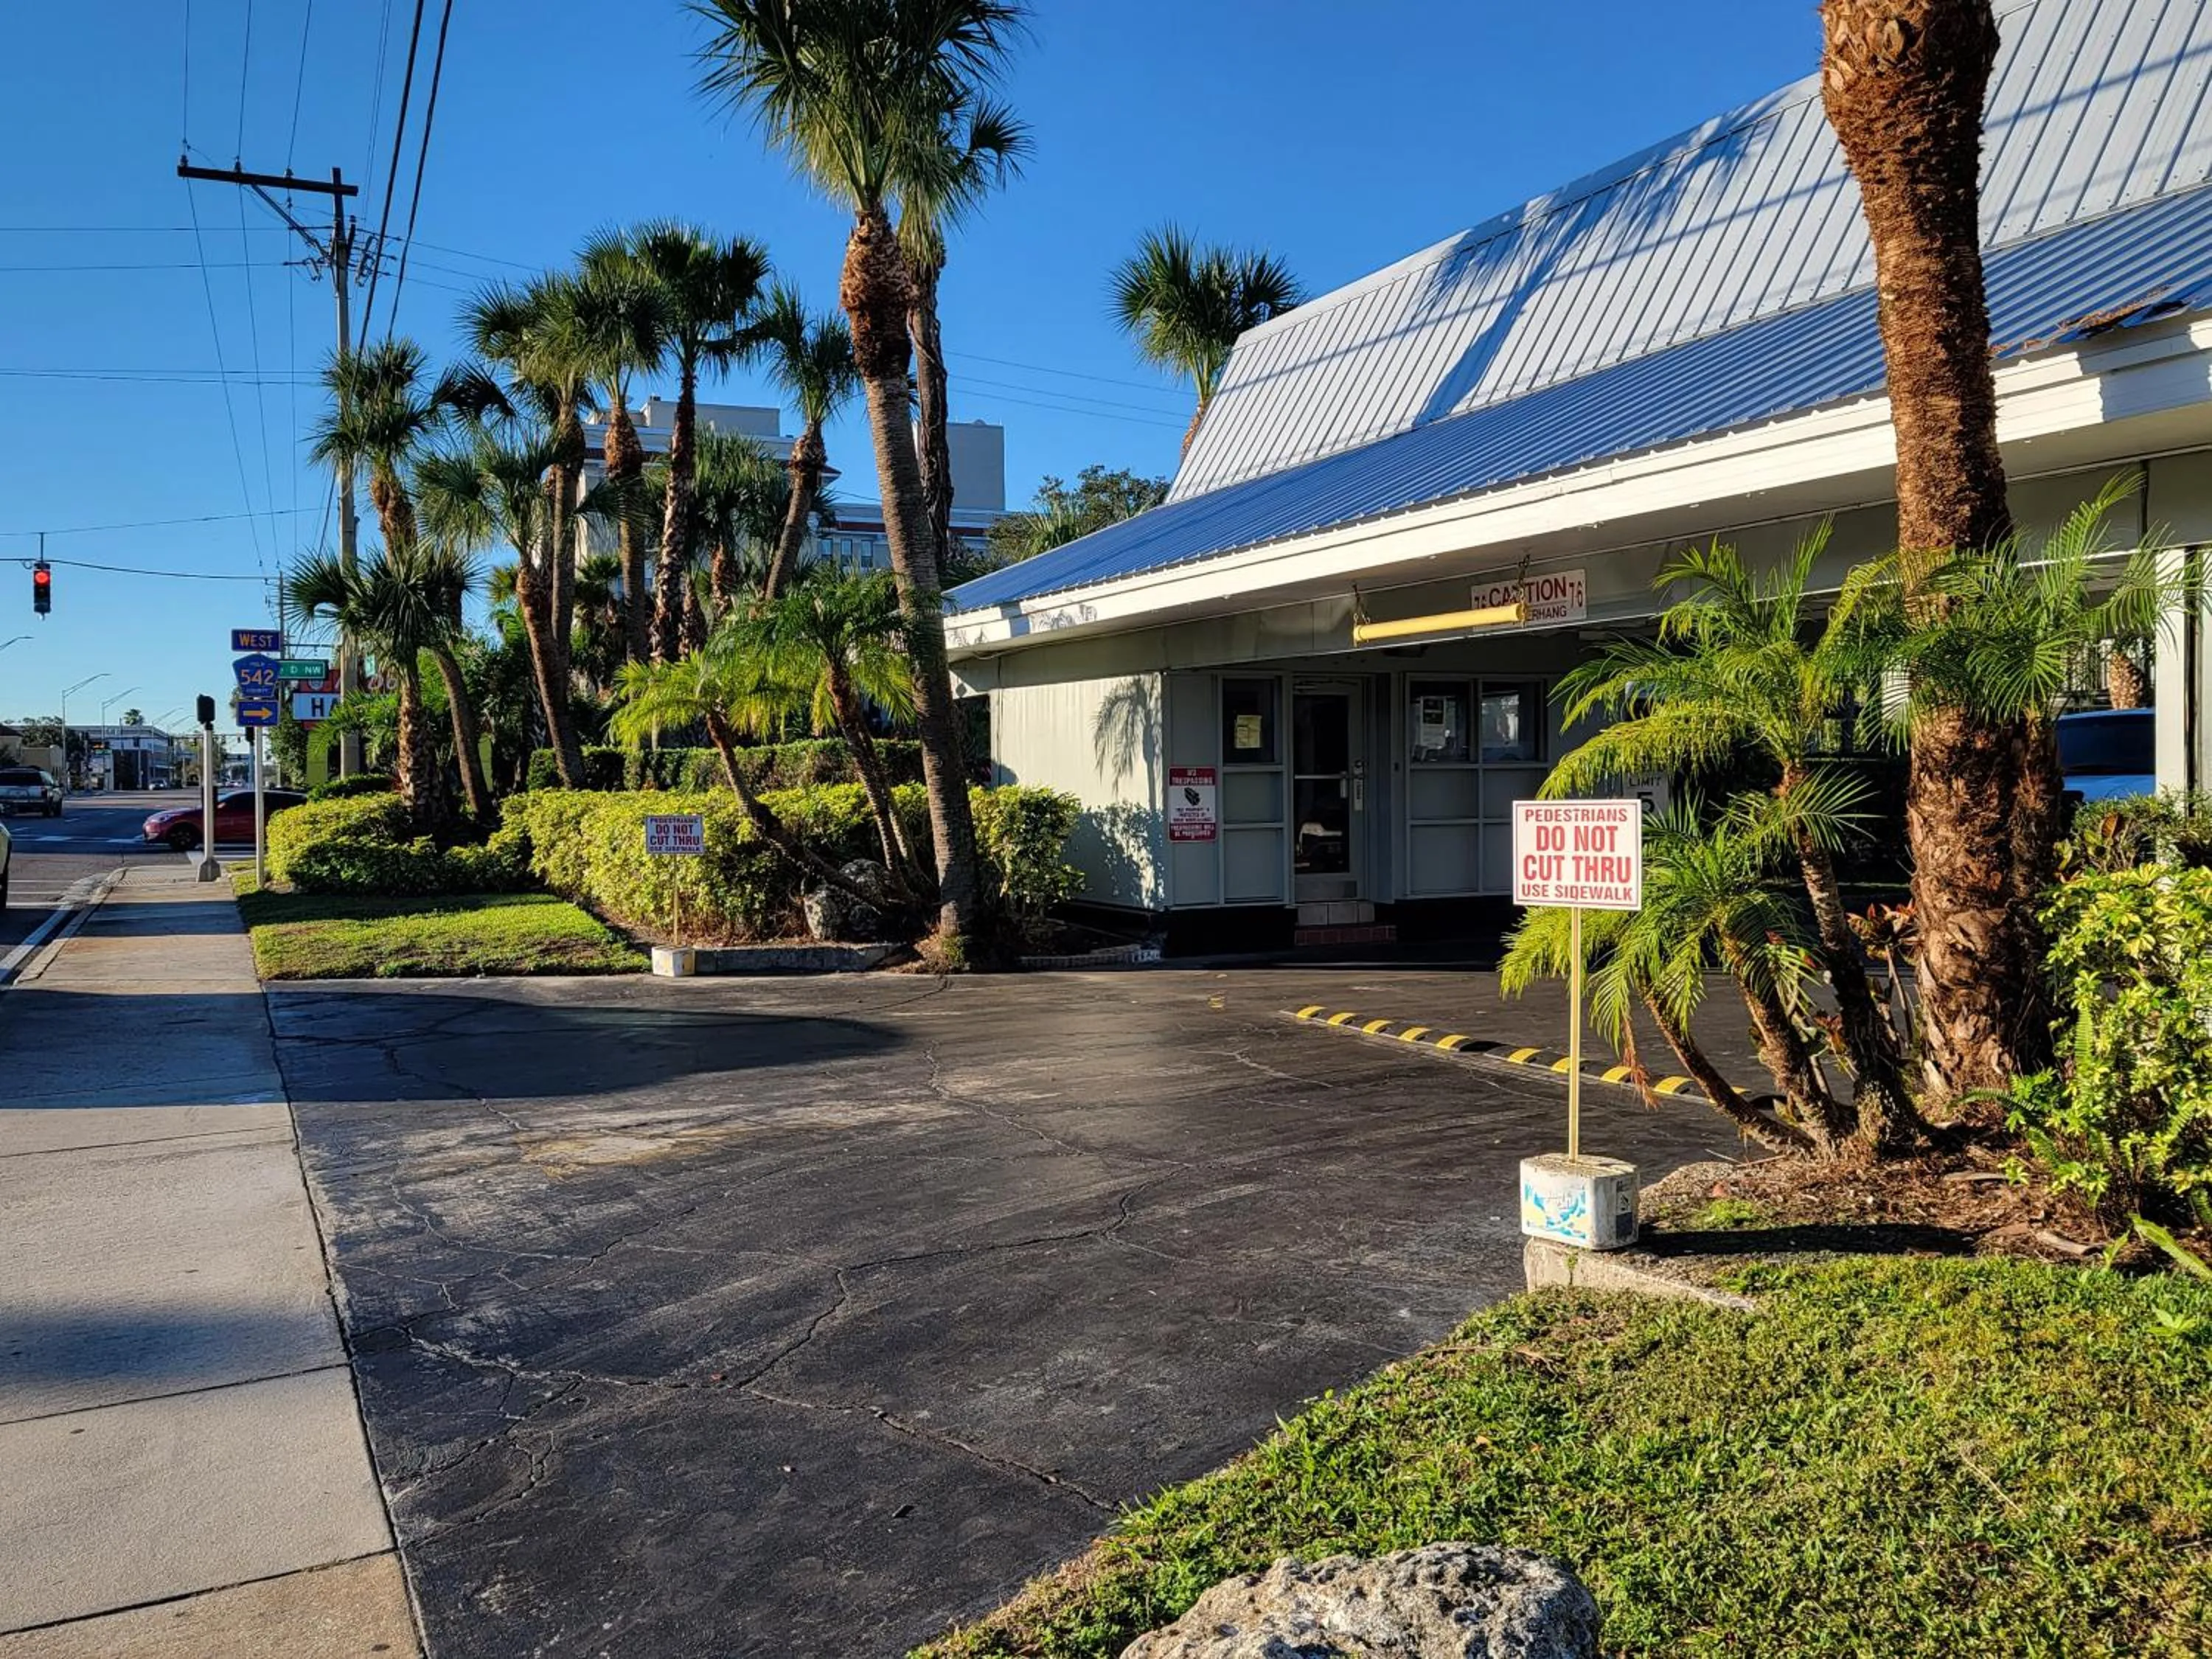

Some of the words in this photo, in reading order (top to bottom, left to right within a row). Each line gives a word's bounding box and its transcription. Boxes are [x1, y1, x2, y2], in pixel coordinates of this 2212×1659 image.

[1526, 605, 1567, 621] ERHANG
[239, 633, 274, 647] WEST
[241, 669, 274, 685] 542
[305, 666, 321, 675] NW
[1636, 792, 1655, 814] 5
[1525, 808, 1627, 822] PEDESTRIANS
[655, 824, 669, 834] DO
[673, 824, 693, 834] NOT
[650, 836, 669, 845] CUT
[672, 836, 700, 845] THRU
[1536, 825, 1565, 852] DO
[1574, 825, 1618, 852] NOT
[1523, 855, 1565, 881] CUT
[1571, 855, 1632, 883] THRU
[1522, 883, 1549, 897] USE
[1554, 885, 1632, 901] SIDEWALK
